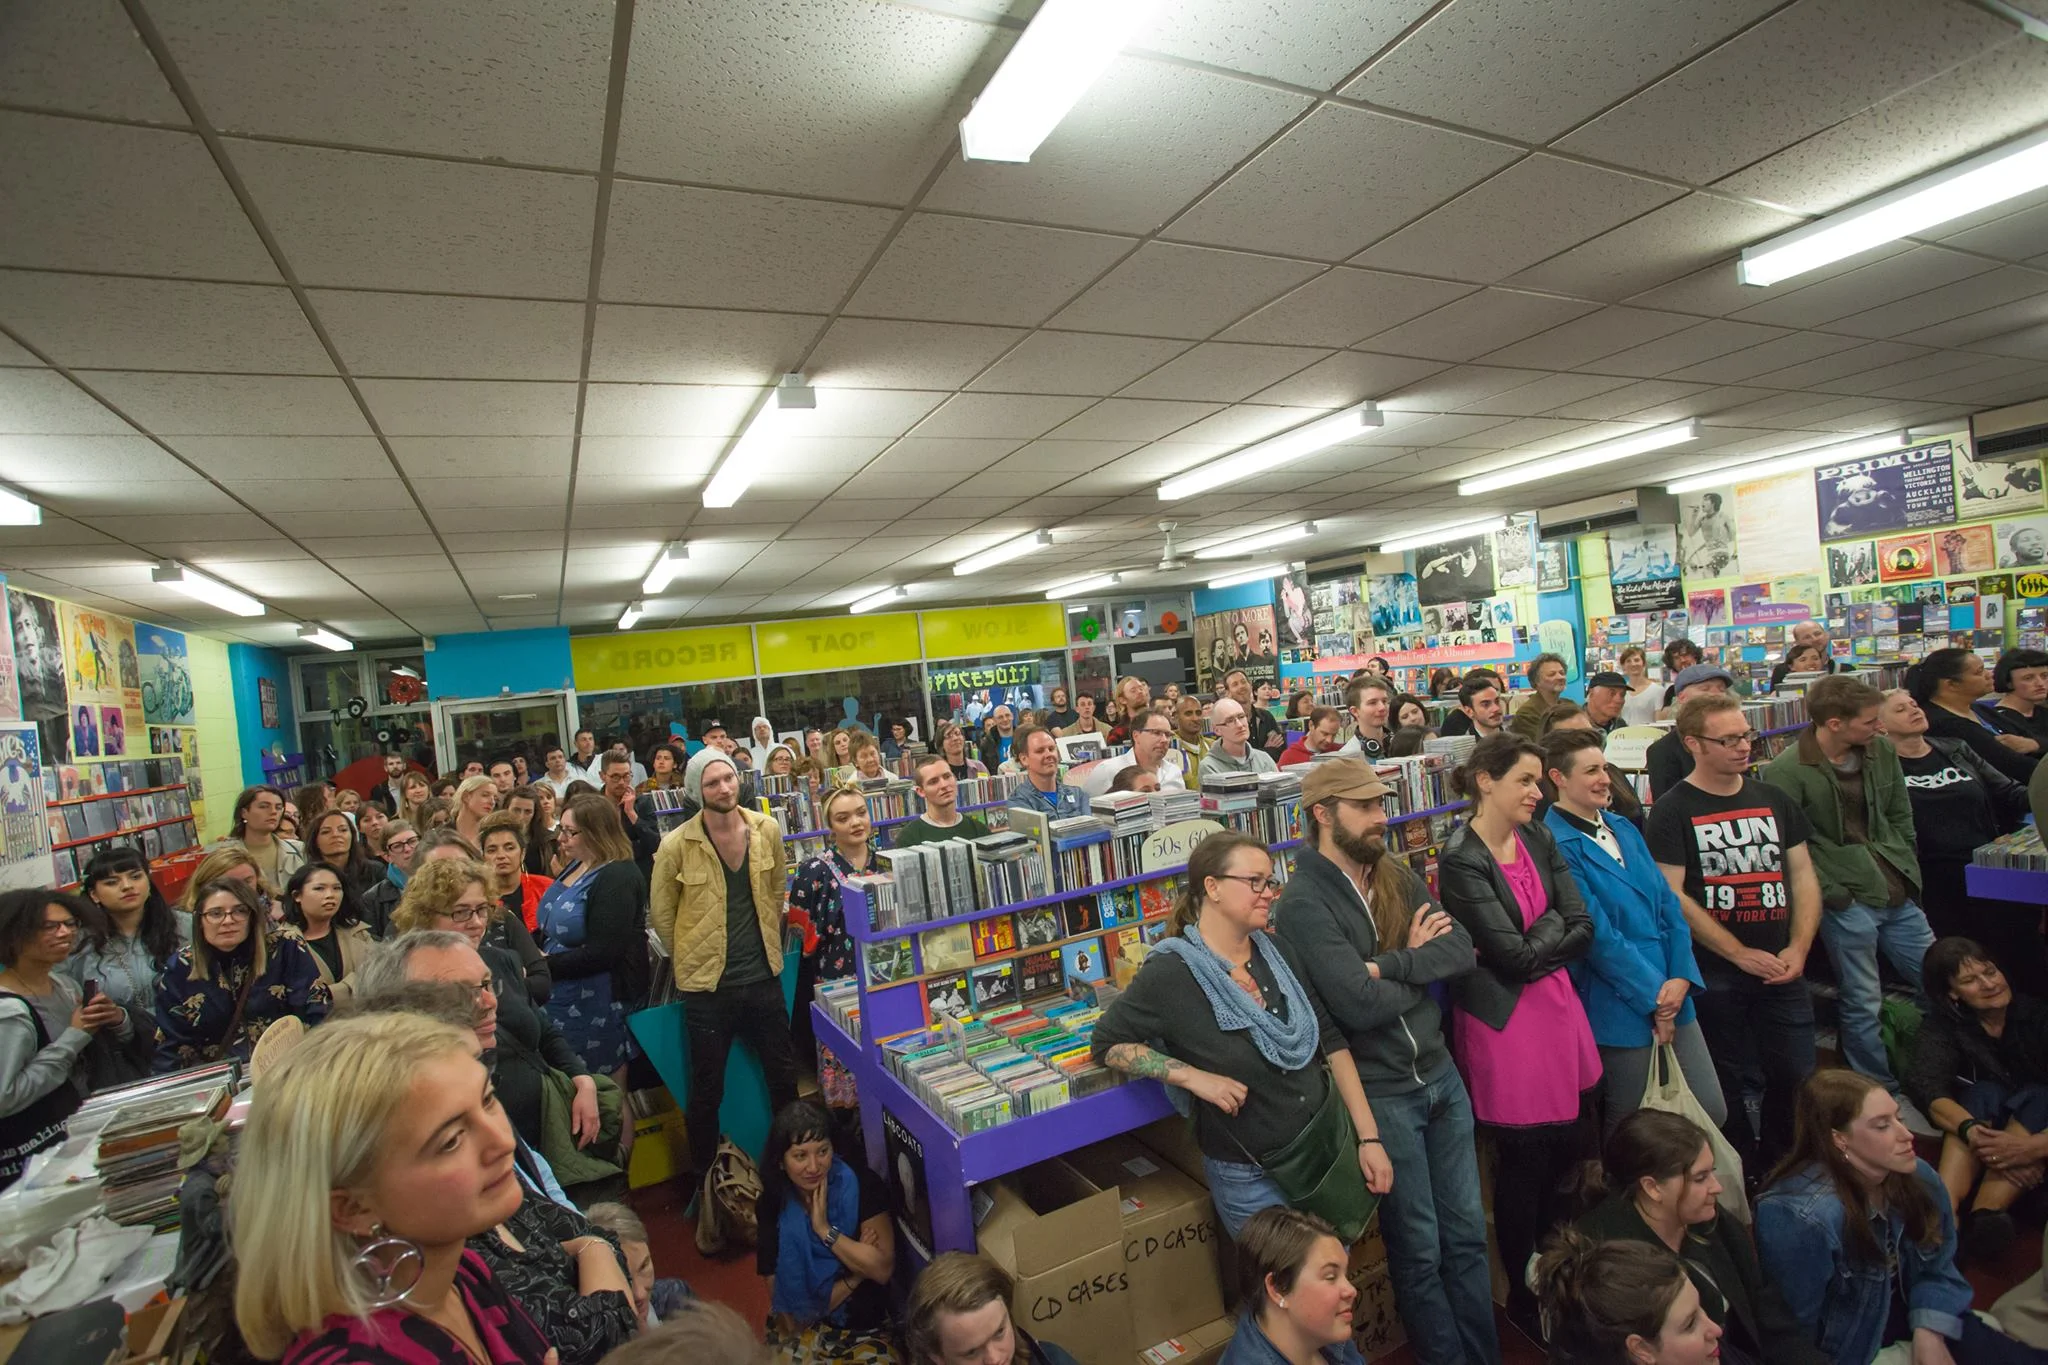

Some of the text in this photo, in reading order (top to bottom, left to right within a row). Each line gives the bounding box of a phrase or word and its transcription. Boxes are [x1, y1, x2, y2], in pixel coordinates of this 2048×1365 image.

[1818, 444, 1952, 481] PRIMUS
[1903, 464, 1951, 478] WELLINGTON
[1904, 480, 1937, 489] VICTORIA
[1905, 485, 1953, 499] AUCKLAND
[1906, 497, 1953, 510] TOWN HALL
[1626, 583, 1640, 592] Kids
[1641, 581, 1652, 591] Are
[1224, 611, 1239, 625] NO
[1241, 606, 1270, 624] MORE
[1758, 609, 1775, 618] Rock
[1412, 651, 1427, 662] Top
[1429, 649, 1441, 660] 50
[1443, 647, 1476, 658] Albums
[1694, 817, 1780, 851] RUN
[1152, 836, 1181, 858] 50s
[1700, 843, 1781, 877] DMC
[1704, 882, 1786, 910] 19 88
[1736, 909, 1766, 922] YORK
[882, 1111, 923, 1158] LABCOATS
[1126, 1221, 1216, 1262] CD CASES
[1032, 1272, 1128, 1322] CD CASES
